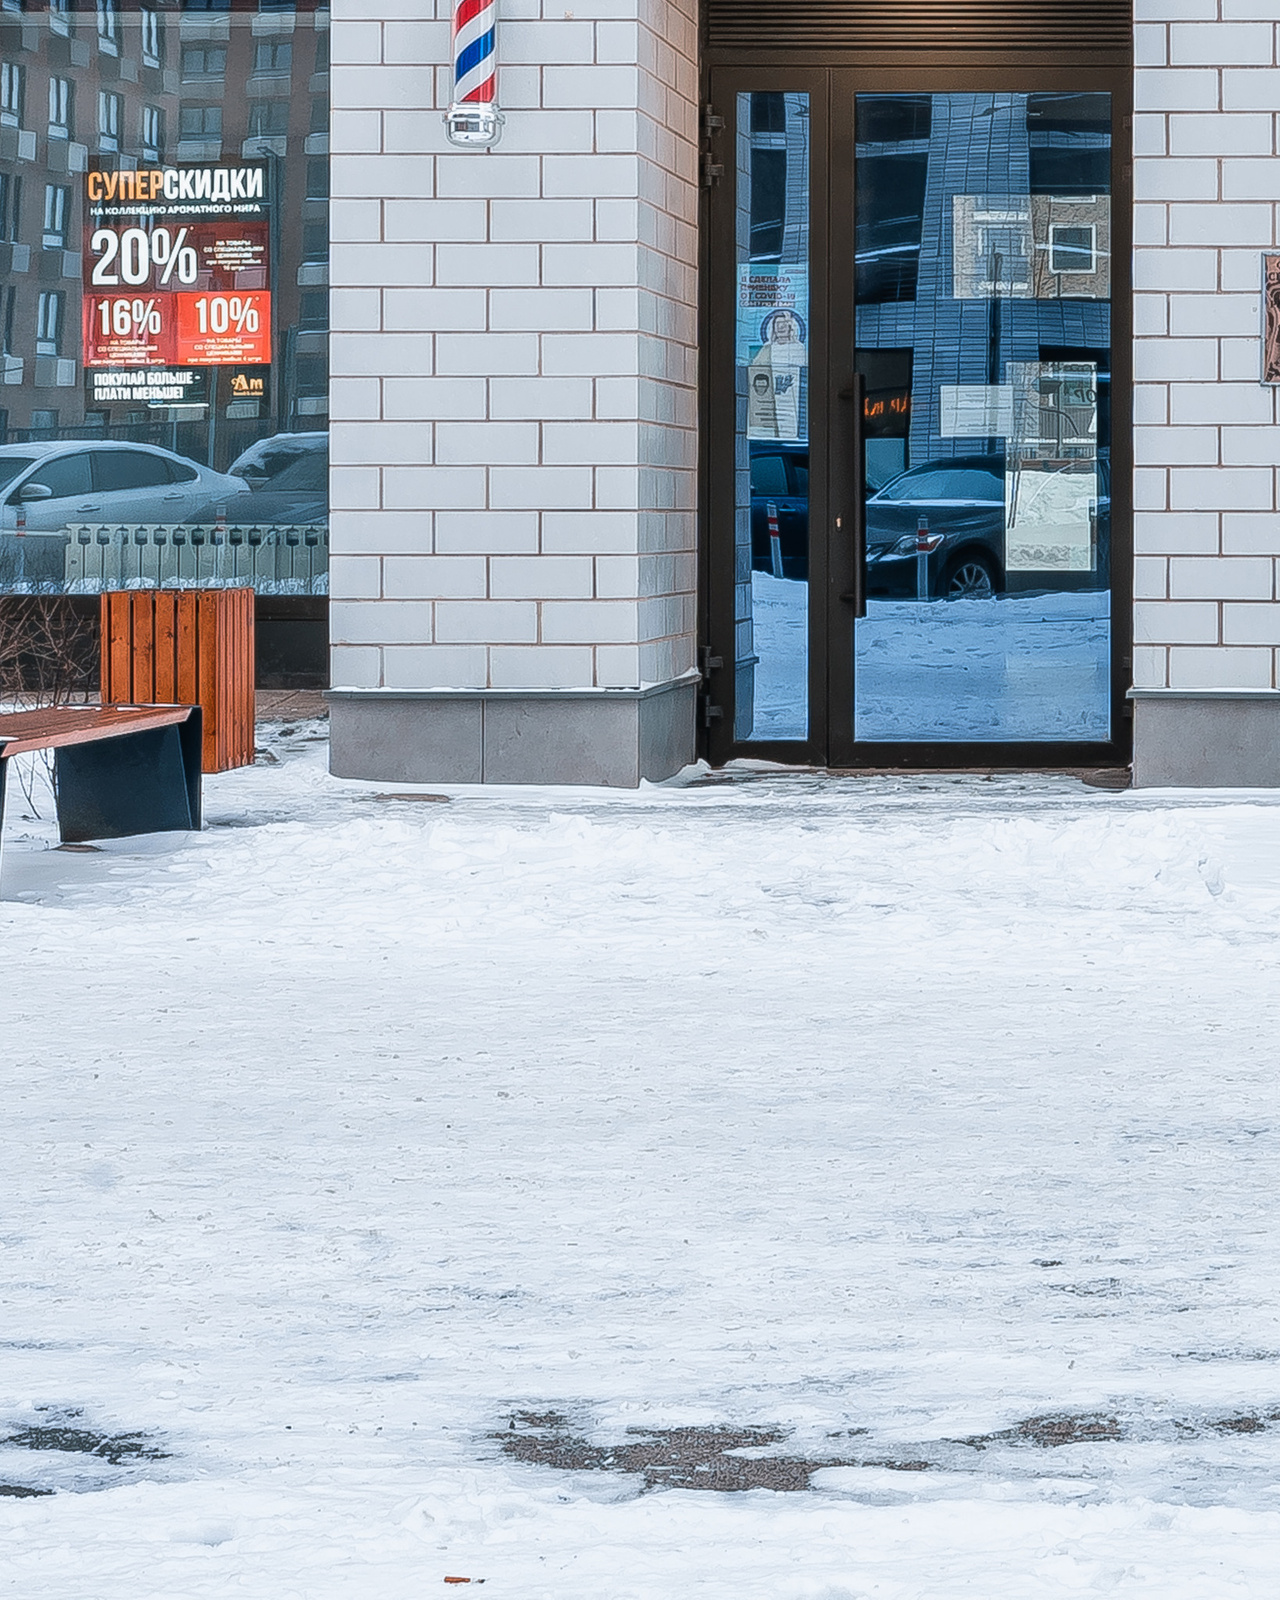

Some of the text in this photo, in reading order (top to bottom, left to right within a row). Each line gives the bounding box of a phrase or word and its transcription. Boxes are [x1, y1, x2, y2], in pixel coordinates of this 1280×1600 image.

[87, 168, 263, 202] СУПЕРСКИДКИ
[90, 203, 261, 215] НА КОЛЛЕКЦИЮ АРОМАТНОГО МИРА
[94, 371, 145, 386] ПОКУПАЙ
[147, 371, 193, 385] БОЛЬШЕ
[94, 386, 184, 401] ПЛАТИ МЕНЬШЕ!
